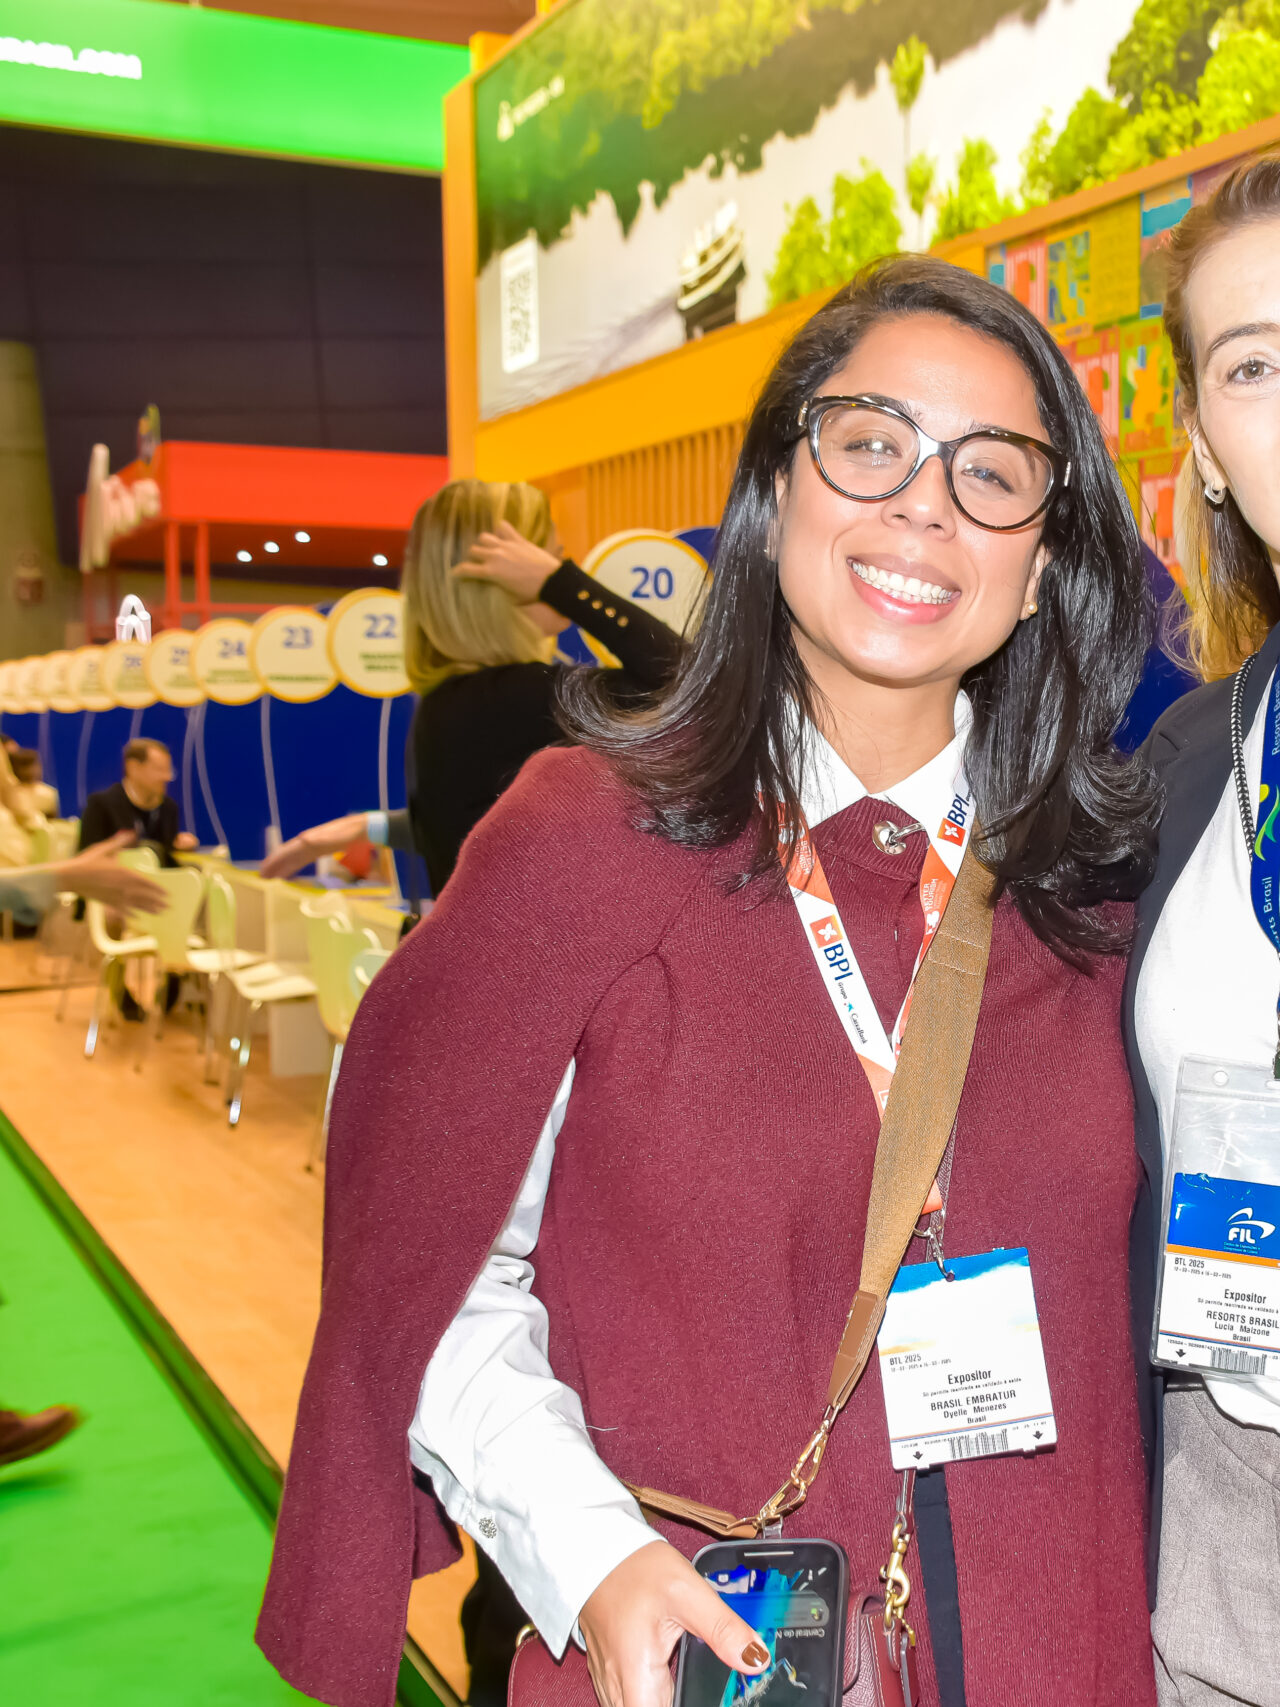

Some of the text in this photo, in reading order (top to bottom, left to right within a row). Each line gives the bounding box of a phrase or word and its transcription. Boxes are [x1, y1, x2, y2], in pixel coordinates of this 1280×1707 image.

[631, 566, 674, 599] 20
[363, 613, 398, 640] 22
[282, 625, 314, 650] 23
[1271, 711, 1280, 756] Resorts
[947, 793, 970, 828] BPI
[1262, 876, 1273, 914] Brasil
[823, 942, 854, 982] BPI
[1228, 1227, 1256, 1244] FIL
[1174, 1257, 1205, 1269] BTL 2025
[1224, 1288, 1267, 1304] Expositor
[1206, 1310, 1280, 1329] RESORTS BRASIL
[1232, 1333, 1251, 1342] Brasil
[889, 1356, 902, 1366] BTL
[904, 1353, 922, 1364] 2025
[947, 1370, 991, 1385] Expositor
[930, 1389, 1016, 1411] BRASIL EMBRATUR
[973, 1402, 1007, 1413] Menezes
[967, 1415, 986, 1424] Brasil
